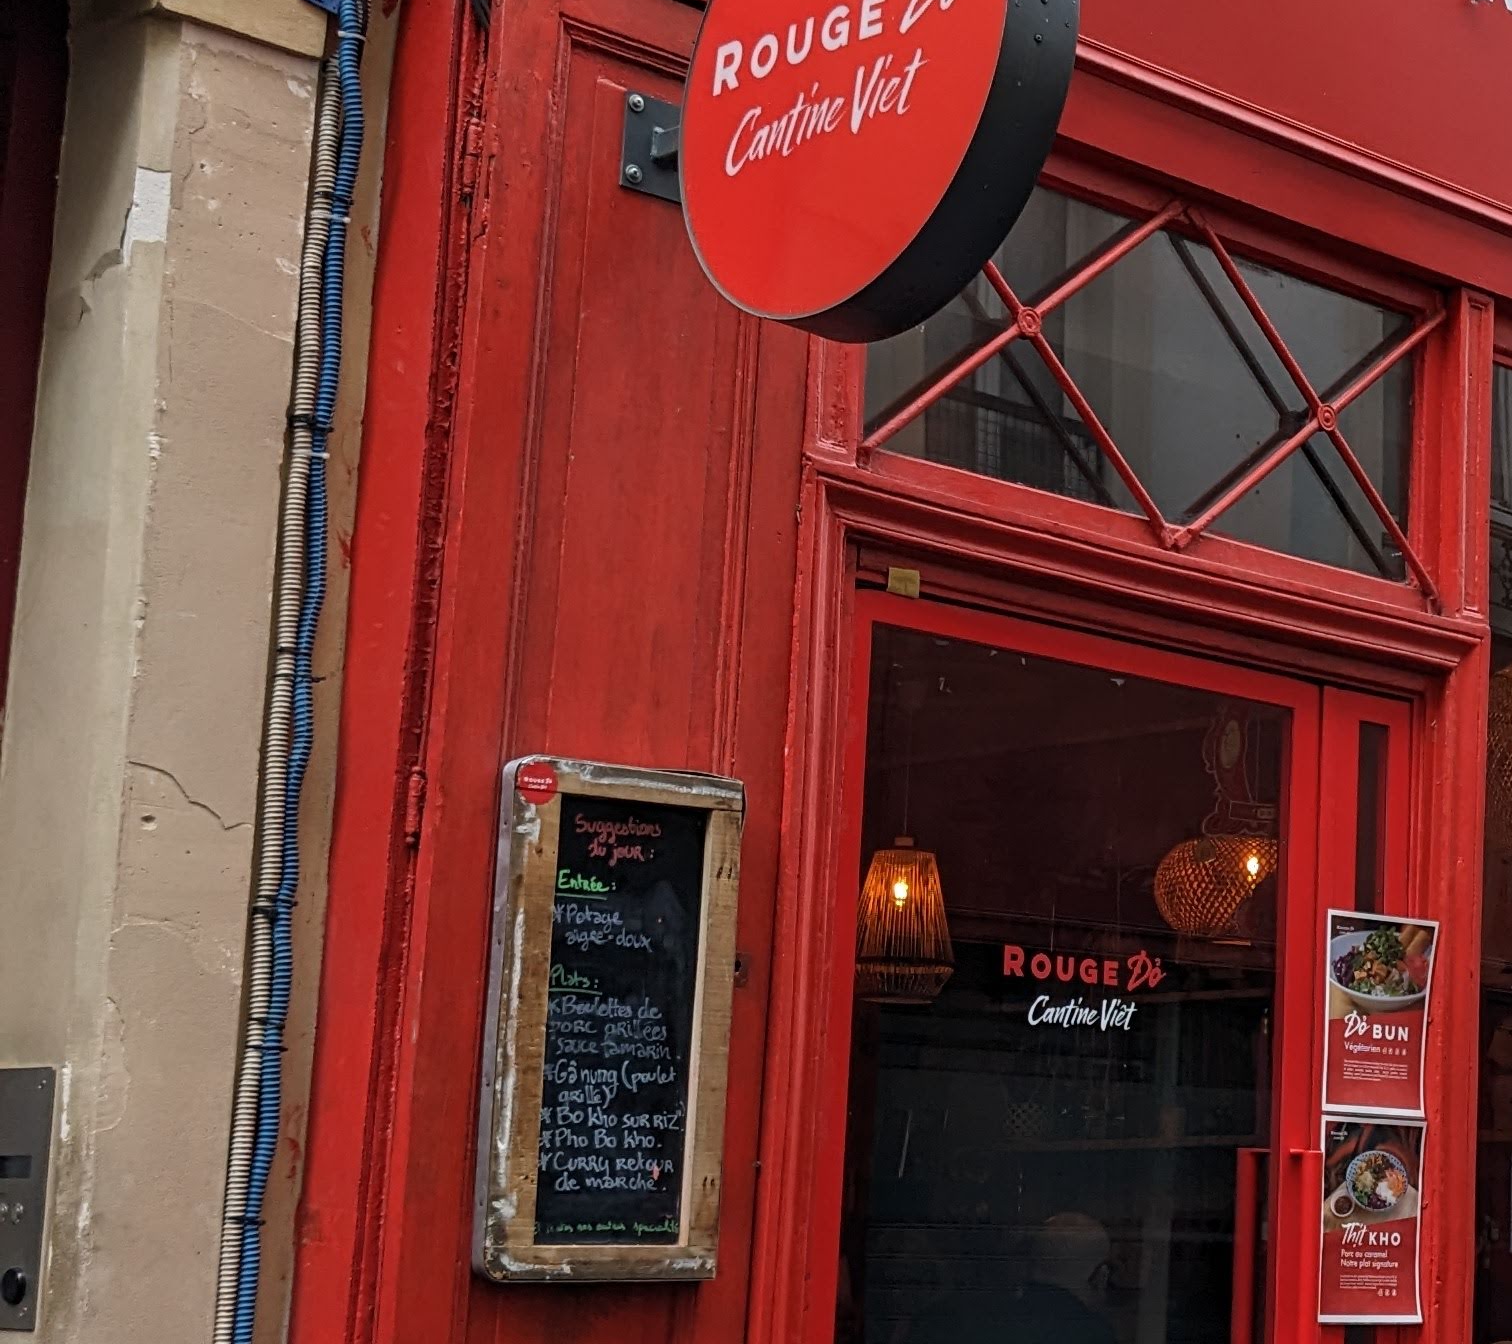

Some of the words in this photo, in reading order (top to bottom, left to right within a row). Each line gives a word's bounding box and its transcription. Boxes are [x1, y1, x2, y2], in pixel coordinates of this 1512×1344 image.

[724, 81, 847, 177] Cantine
[574, 813, 662, 844] Suggestions
[588, 838, 607, 857] du
[566, 903, 624, 934] Potage
[1003, 944, 1119, 986] ROUGE
[561, 994, 633, 1019] Boulettes
[637, 996, 663, 1019] de
[1027, 994, 1101, 1028] Cantine
[1372, 1023, 1409, 1042] BUN
[556, 1106, 584, 1125] Bo
[554, 1128, 588, 1148] Pho
[594, 1128, 618, 1149] Bo
[554, 1171, 580, 1192] de
[1368, 1231, 1401, 1247] KHO
[1340, 1248, 1354, 1258] Porc
[1364, 1249, 1388, 1258] caramel
[1340, 1258, 1358, 1267] Notre
[1371, 1259, 1399, 1270] signature
